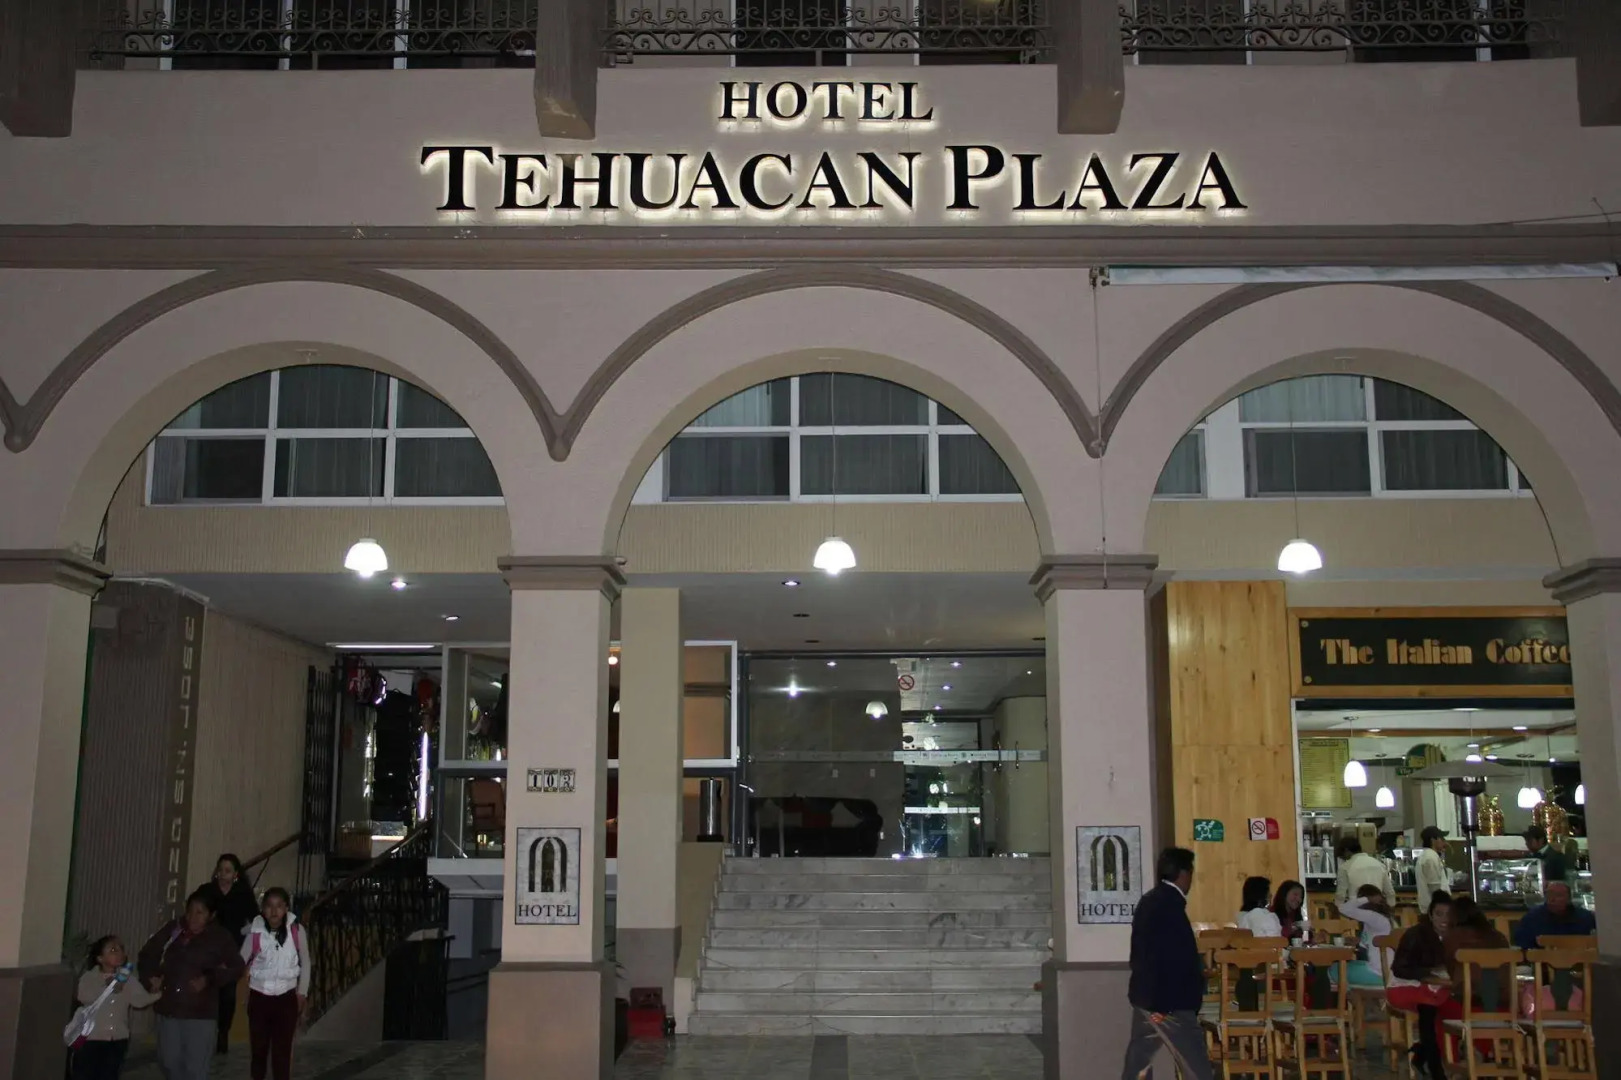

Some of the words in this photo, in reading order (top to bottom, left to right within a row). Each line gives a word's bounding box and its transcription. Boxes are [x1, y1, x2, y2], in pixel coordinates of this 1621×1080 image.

[718, 81, 934, 120] HOTEL
[420, 145, 922, 211] TEHUACAN
[945, 145, 1249, 211] PLAZA
[1320, 638, 1374, 665] The
[1386, 638, 1473, 665] Italian
[180, 616, 194, 728] JOSE
[518, 904, 577, 917] HOTEL
